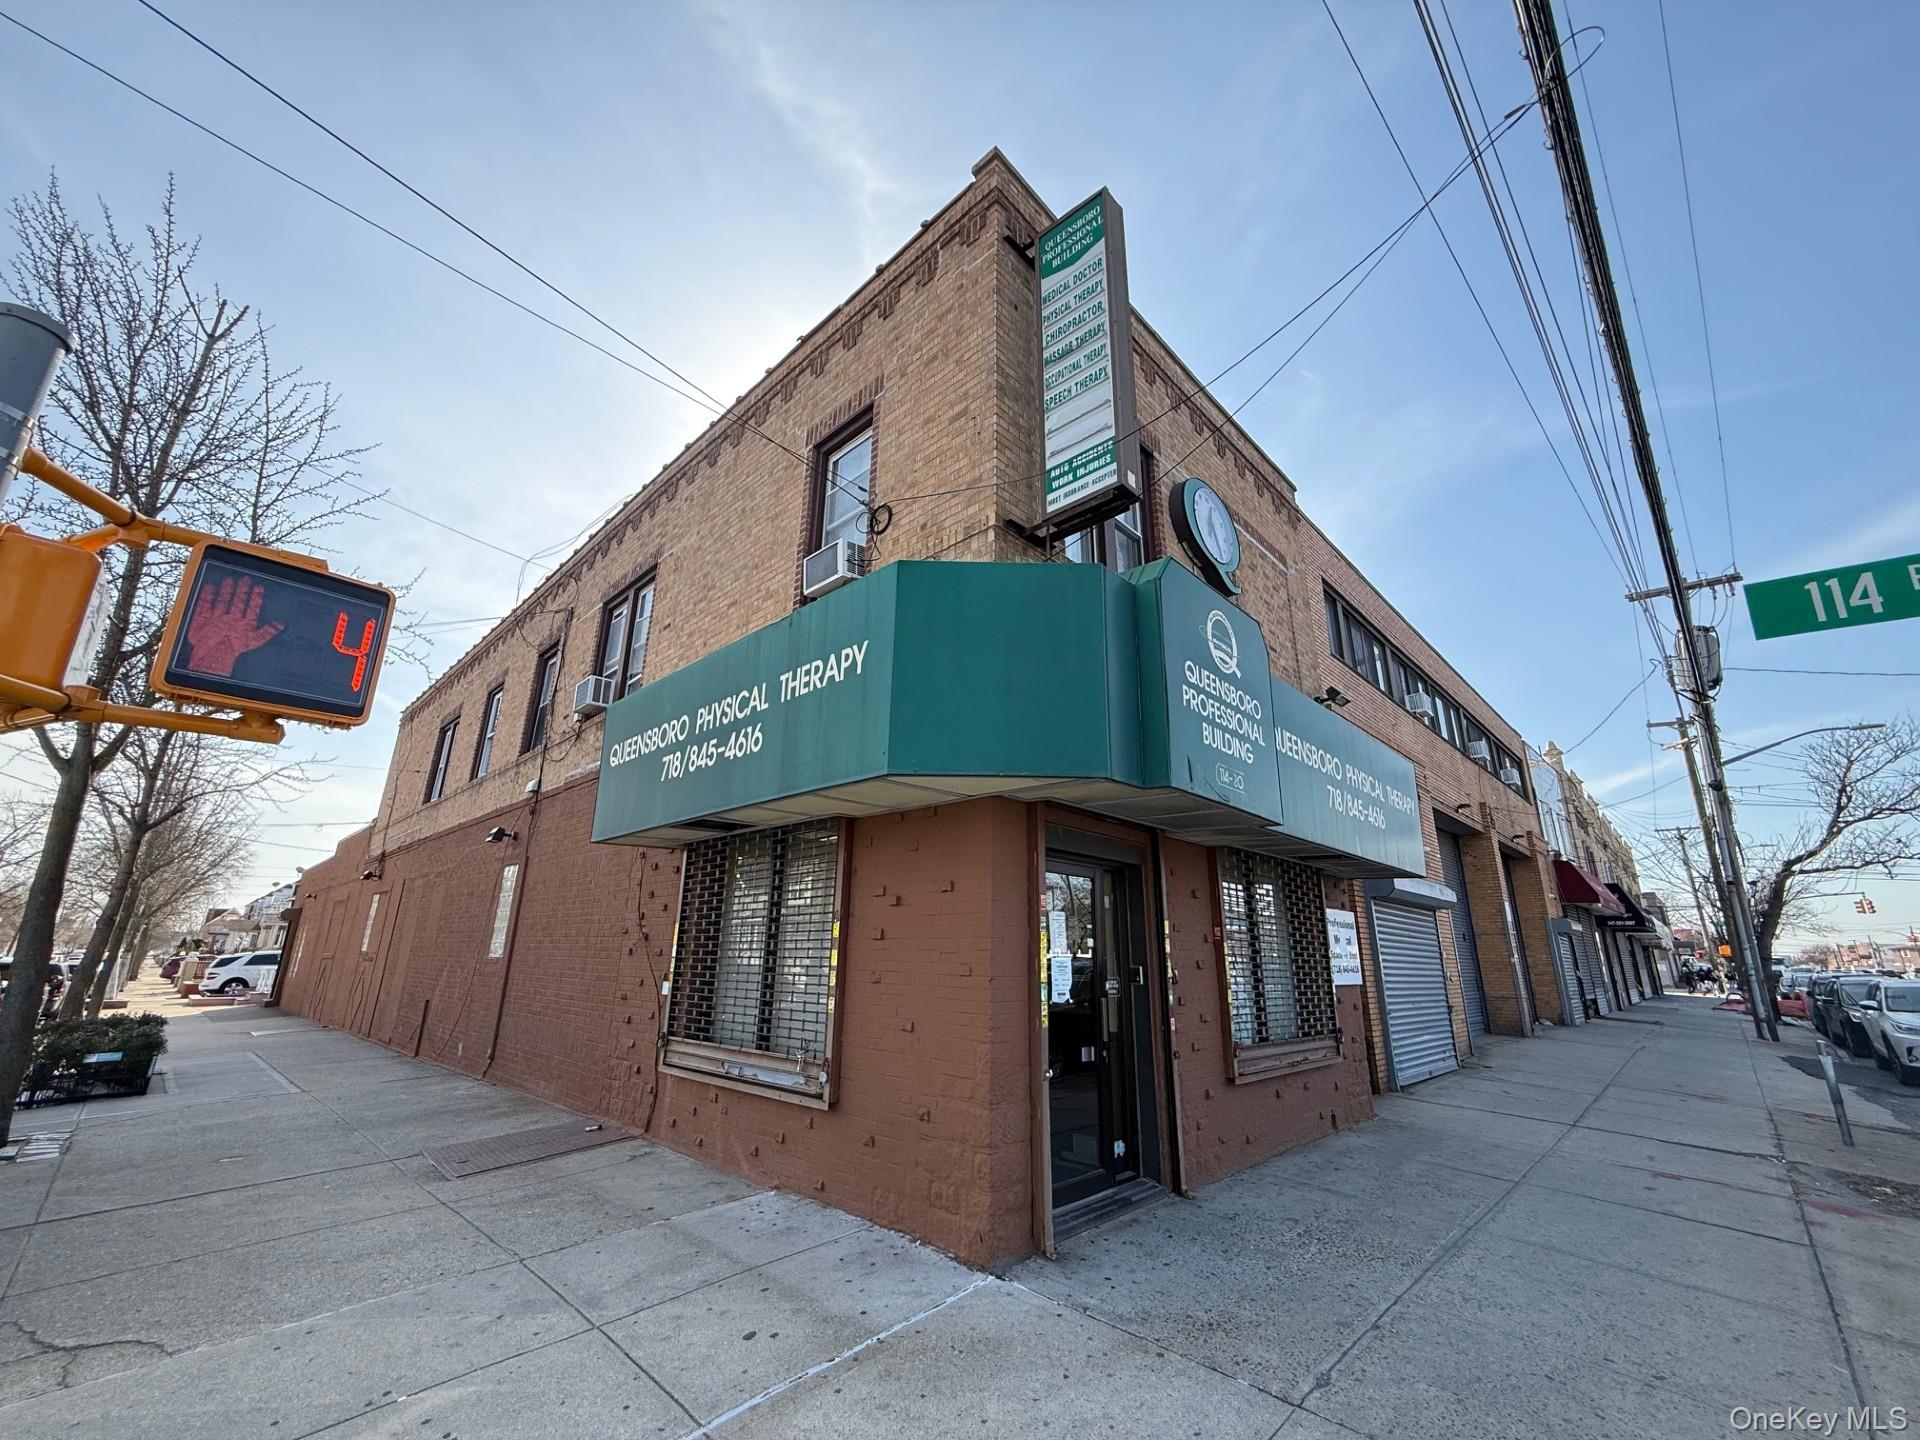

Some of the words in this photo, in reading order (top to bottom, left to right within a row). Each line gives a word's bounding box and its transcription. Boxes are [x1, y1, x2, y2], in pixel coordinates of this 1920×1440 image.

[1042, 215, 1103, 264] PROFESSIONAL
[1045, 205, 1100, 251] QUEENSBORO
[1052, 233, 1093, 268] BUILDING
[1042, 279, 1071, 305] MEDICAL
[1073, 257, 1103, 286] DOCTOR
[1042, 299, 1071, 325] PHYSICAL
[1073, 278, 1103, 306] THERAPY
[1043, 338, 1074, 367] MASSAGE
[1075, 321, 1106, 348] THERAPY
[1045, 301, 1103, 345] CHIROPRACTOR
[1044, 359, 1082, 389] OCCUPATIONAL
[1084, 342, 1106, 365] THERAPY
[1045, 386, 1072, 410] SPEECH
[1075, 364, 1108, 393] THERAPY
[1050, 462, 1069, 478] AUTO
[1072, 440, 1113, 467] ACCIDENTS
[1051, 472, 1073, 489] WORK
[1077, 454, 1111, 477] INJURIES
[1091, 469, 1116, 486] ACCEPTED
[1804, 571, 1884, 622] 114
[332, 612, 376, 692] 4
[610, 714, 689, 767] QUEENSBORO
[696, 682, 769, 735] PHYSICAL
[779, 640, 869, 703] THERAPY
[1184, 660, 1262, 720] QUEENSBORO
[1182, 684, 1266, 746] PROFESSIONAL
[661, 722, 763, 782] 718/845-4616
[1202, 722, 1254, 764] BUILDING
[1326, 785, 1386, 830] 718/845-4616
[1345, 763, 1385, 802] PHYSICAL
[1386, 785, 1414, 816] THERAPY
